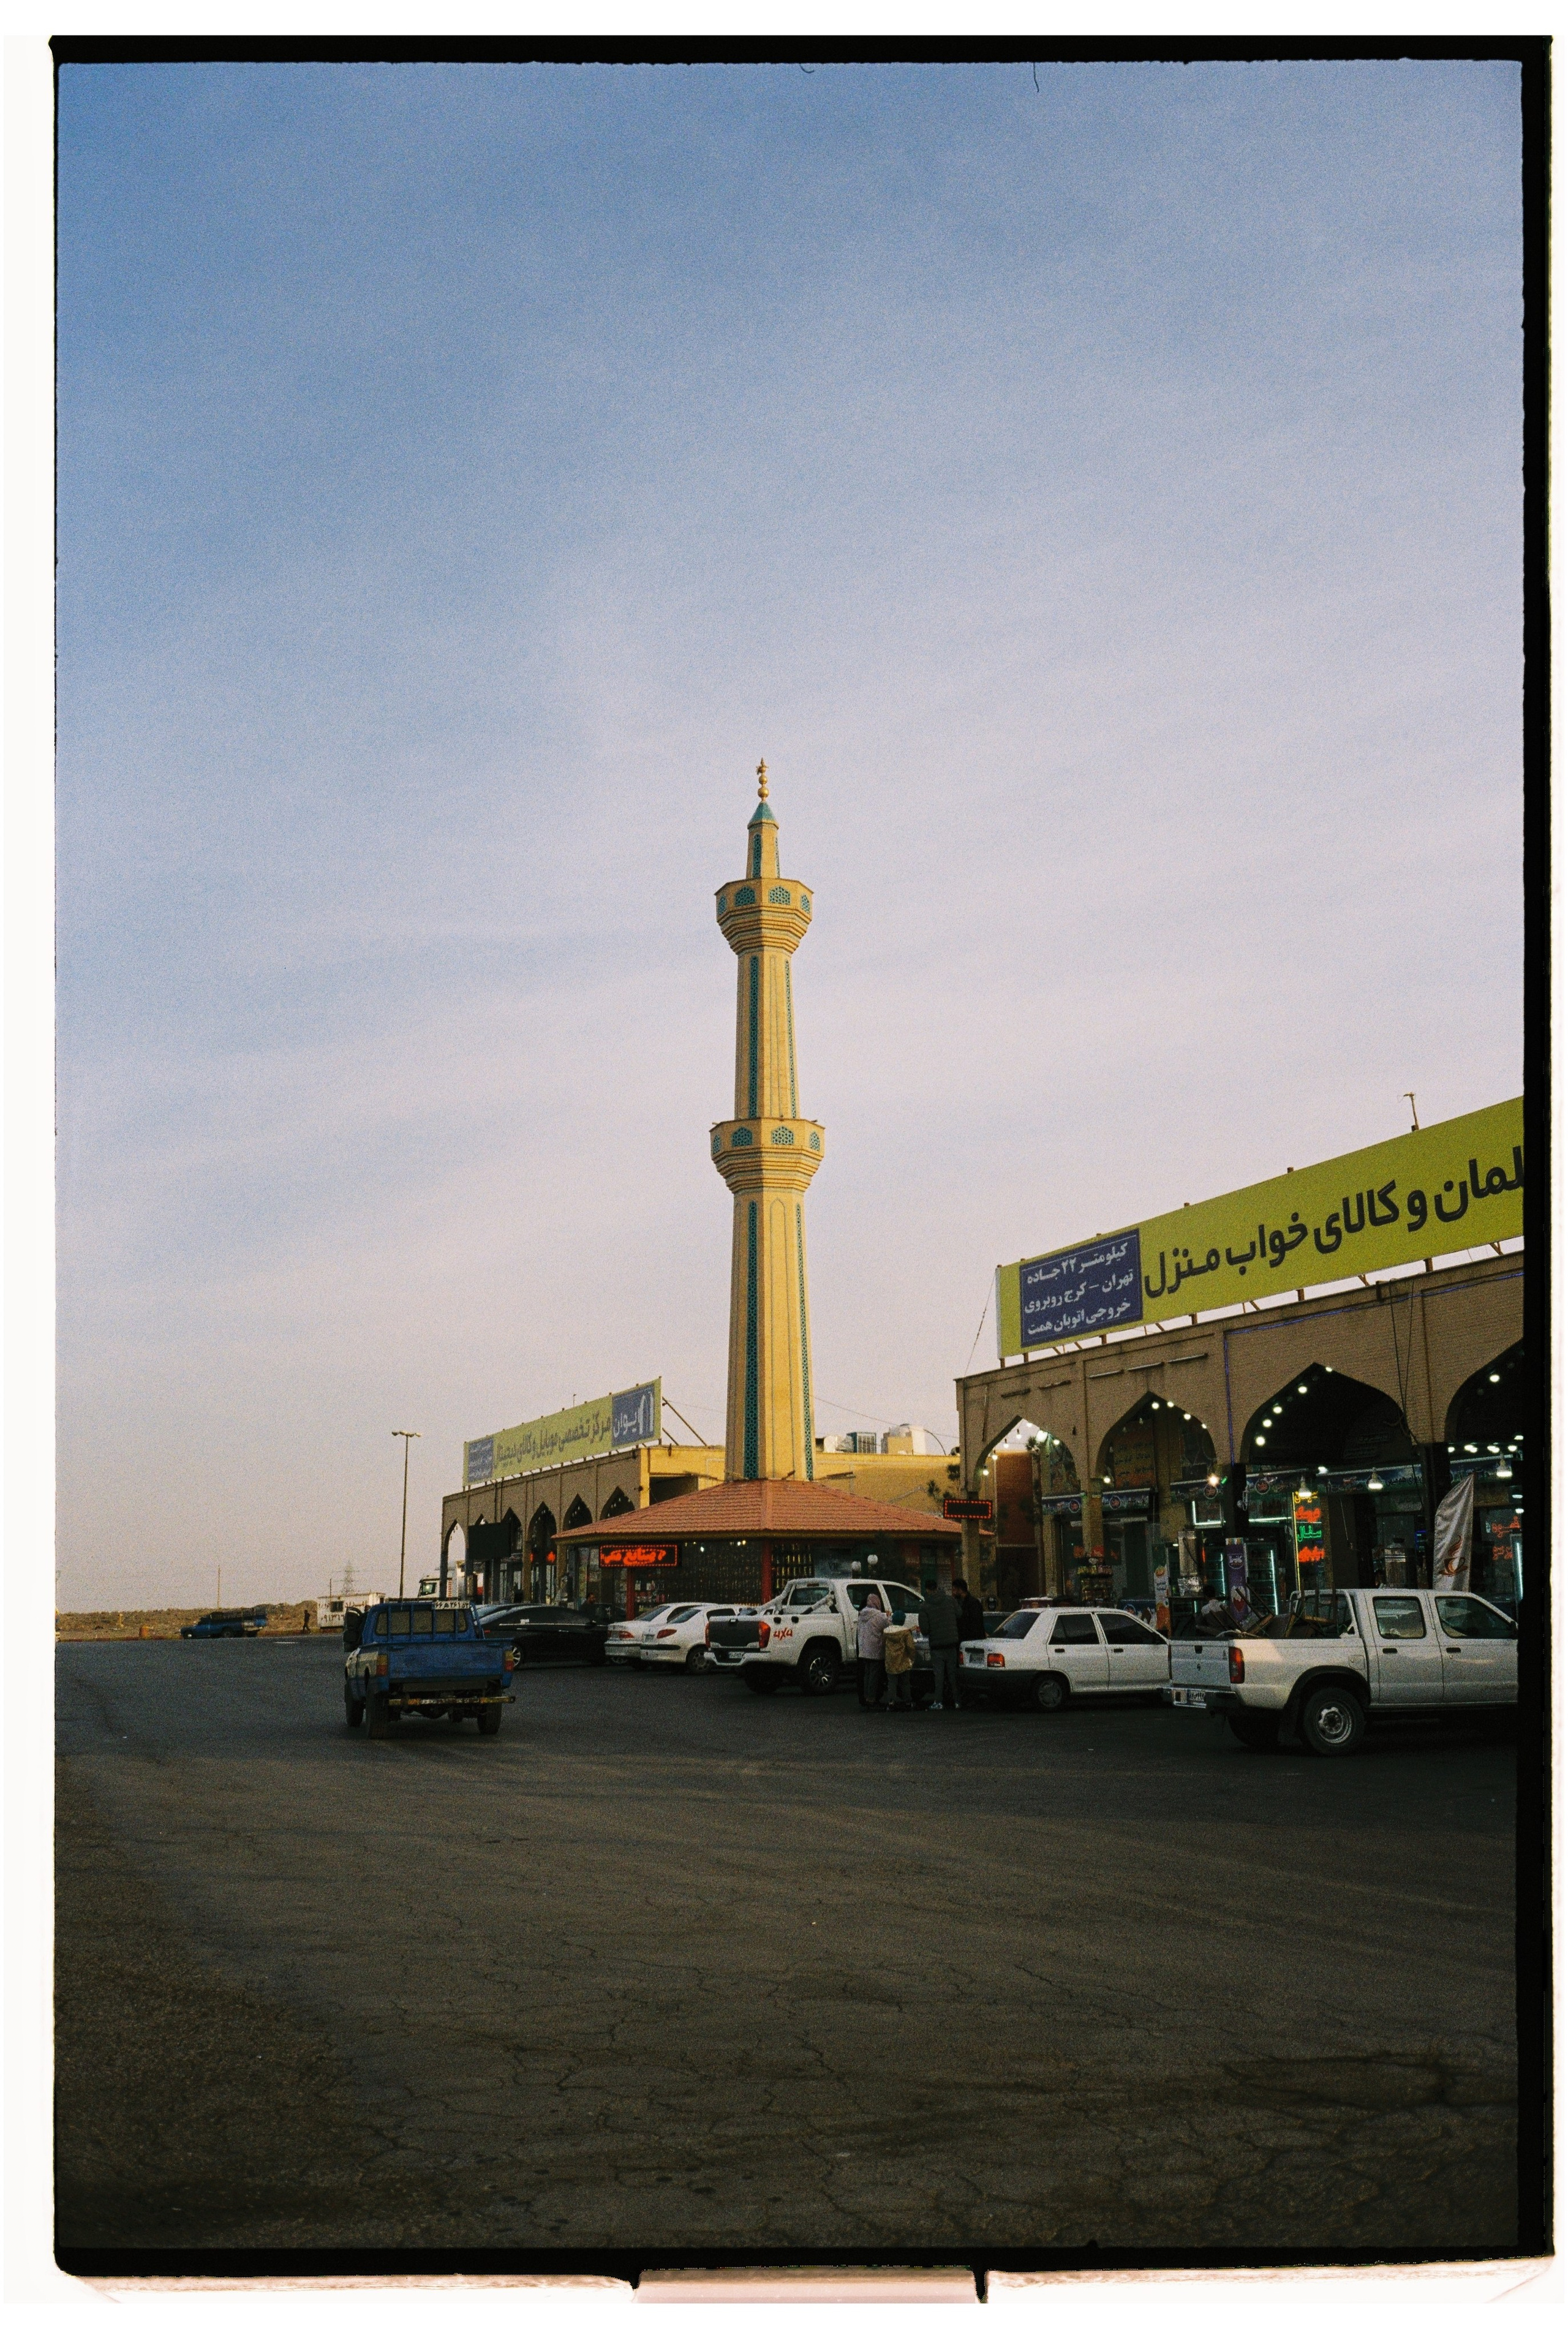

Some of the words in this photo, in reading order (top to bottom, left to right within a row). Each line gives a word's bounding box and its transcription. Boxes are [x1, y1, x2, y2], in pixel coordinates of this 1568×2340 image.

[1435, 1145, 1525, 1224] لمان
[1314, 1180, 1400, 1255] کالای
[1408, 1189, 1428, 1232] و
[1226, 1212, 1308, 1276] خواب
[1027, 1267, 1060, 1285] جاده
[1102, 1269, 1133, 1293] تهران
[1144, 1247, 1221, 1298] منزل
[1024, 1295, 1063, 1313] روبروی
[1064, 1281, 1087, 1302] کرج
[1054, 1308, 1085, 1332] اتوبان
[1085, 1297, 1131, 1325] خروجی
[1027, 1321, 1053, 1335] همت
